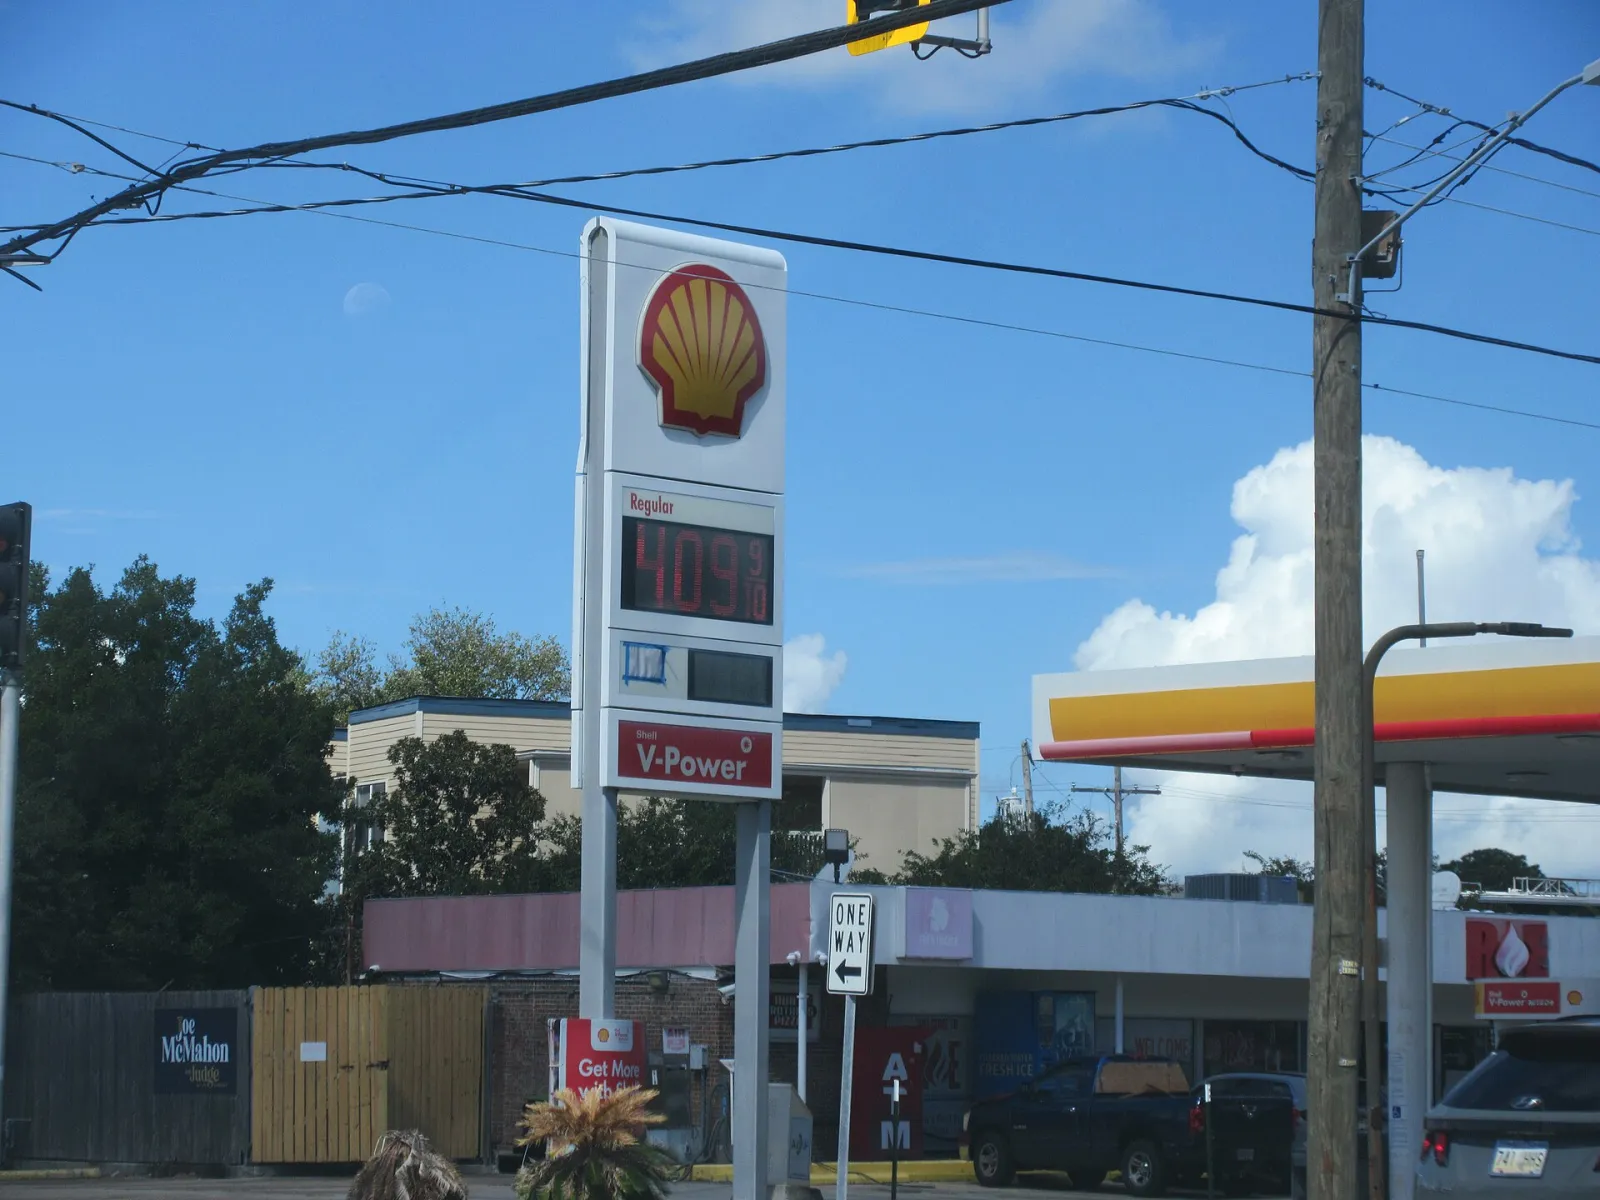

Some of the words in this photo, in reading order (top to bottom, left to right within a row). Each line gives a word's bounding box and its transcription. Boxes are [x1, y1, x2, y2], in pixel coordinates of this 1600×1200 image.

[630, 493, 674, 516] Regular
[636, 730, 658, 741] Shell
[636, 743, 747, 781] V-Power
[836, 903, 866, 926] ONE
[834, 930, 865, 954] WAY
[1488, 998, 1524, 1007] V-Power
[176, 1015, 196, 1042] Joe
[161, 1035, 229, 1063] McMahon
[1134, 1037, 1190, 1058] WELCOME
[189, 1065, 220, 1089] Judge
[578, 1058, 609, 1078] Get
[611, 1059, 640, 1078] More
[979, 1063, 1014, 1077] FRESH
[1016, 1063, 1034, 1076] ICE
